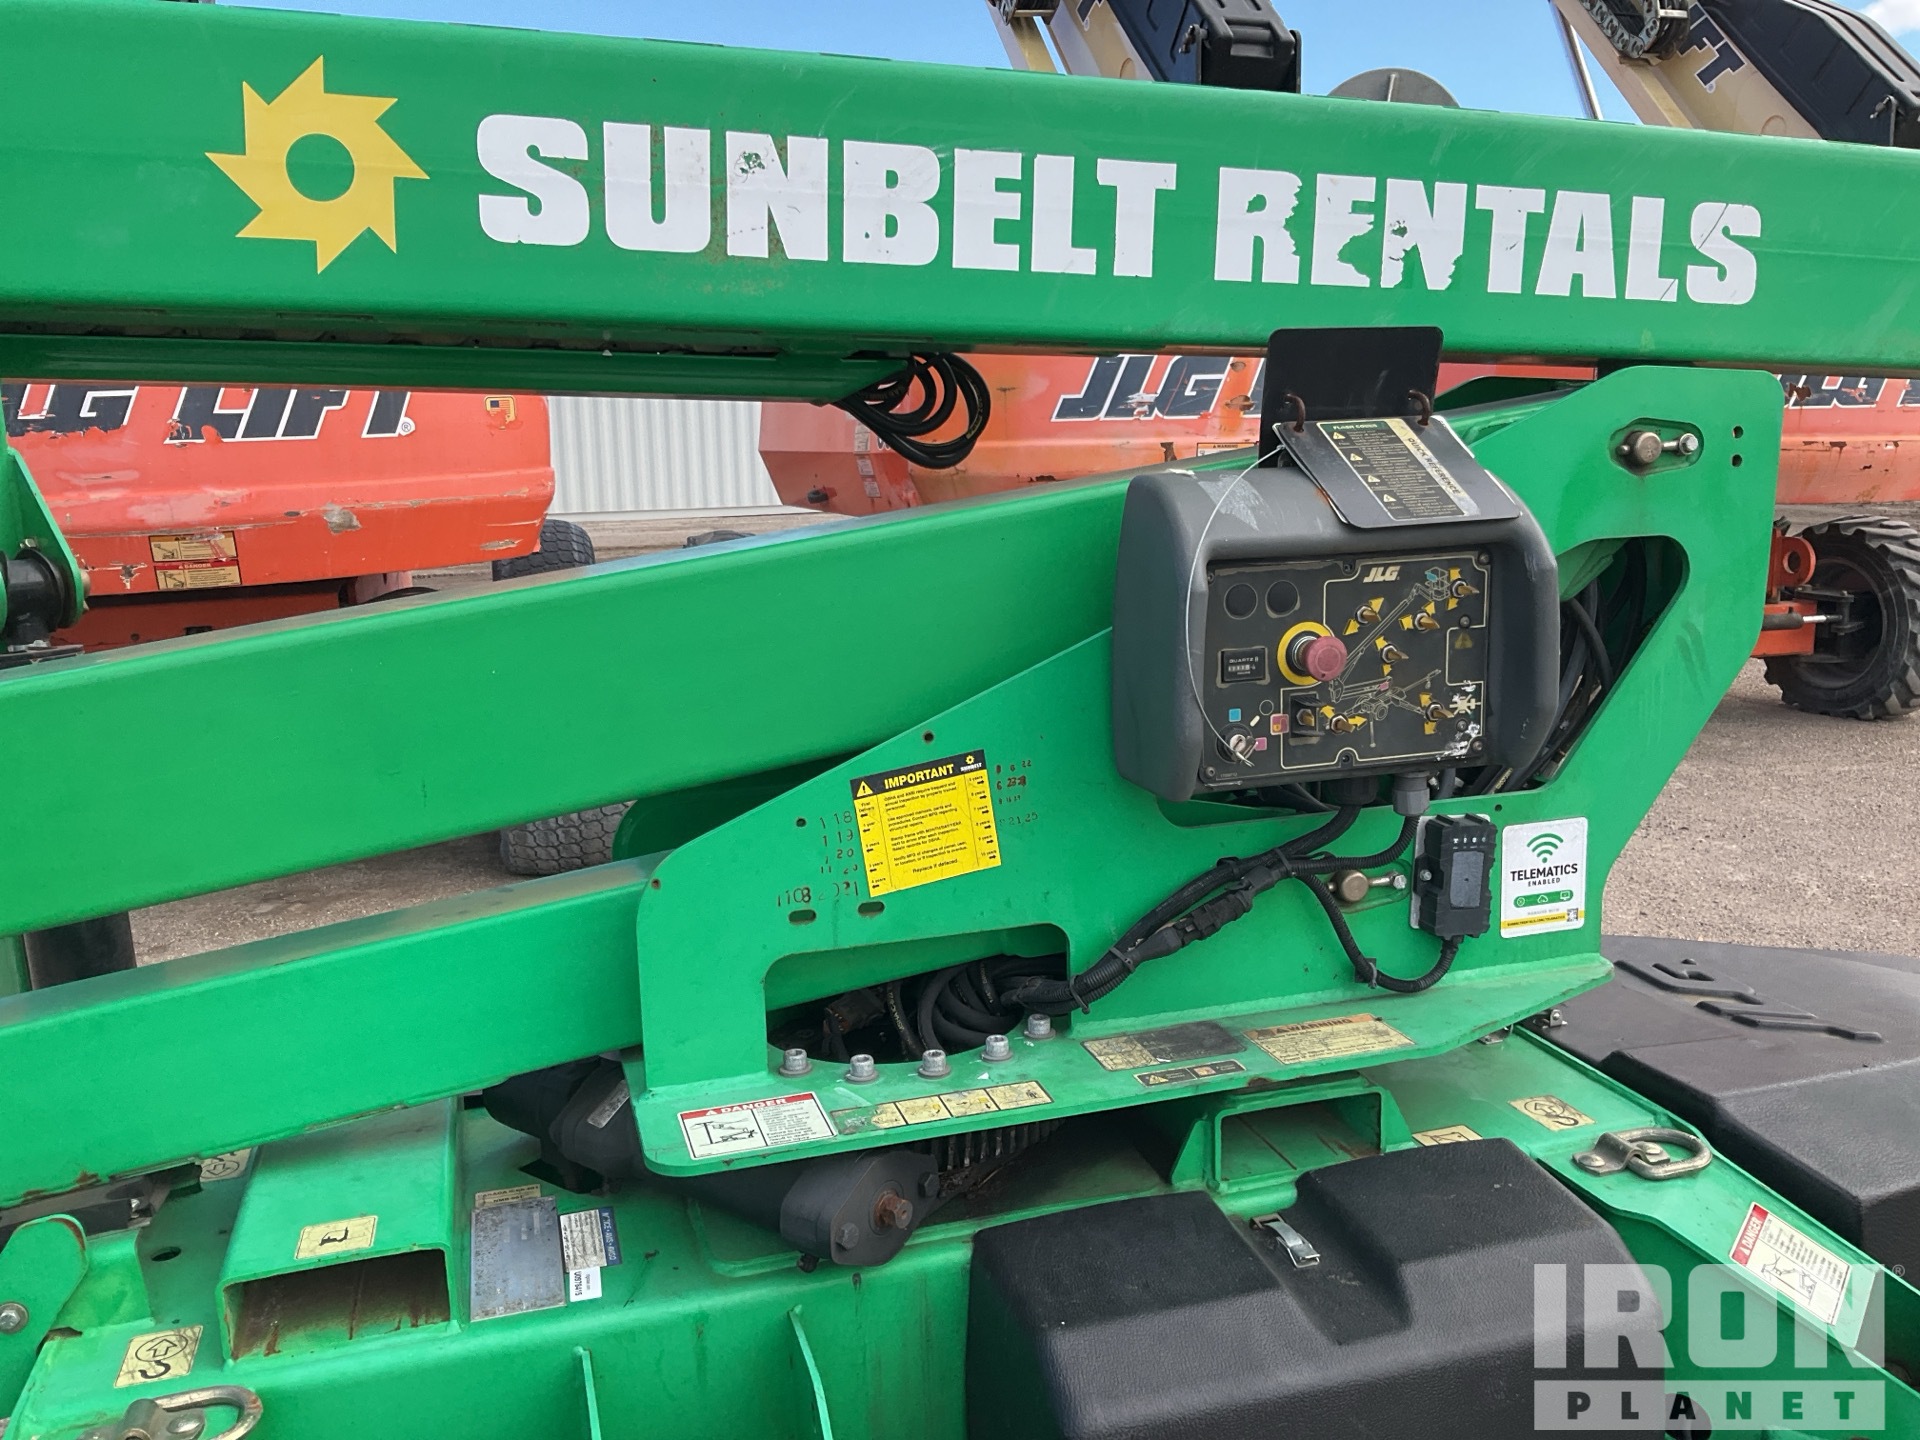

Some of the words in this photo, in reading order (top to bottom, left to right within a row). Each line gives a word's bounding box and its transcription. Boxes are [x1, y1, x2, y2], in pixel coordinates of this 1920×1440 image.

[476, 113, 1177, 278] SUNBELT
[1214, 166, 1762, 306] RENTALS
[1051, 355, 1235, 422] JLG
[1407, 437, 1430, 460] QUICK
[1363, 566, 1399, 583] JLG
[884, 764, 954, 789] IMPORTANT
[1510, 863, 1578, 882] TELEMATICS
[1528, 877, 1561, 887] ENABLED
[1287, 1018, 1352, 1031] WARNING
[721, 1098, 787, 1113] DANGER
[1743, 1216, 1764, 1252] DANGER
